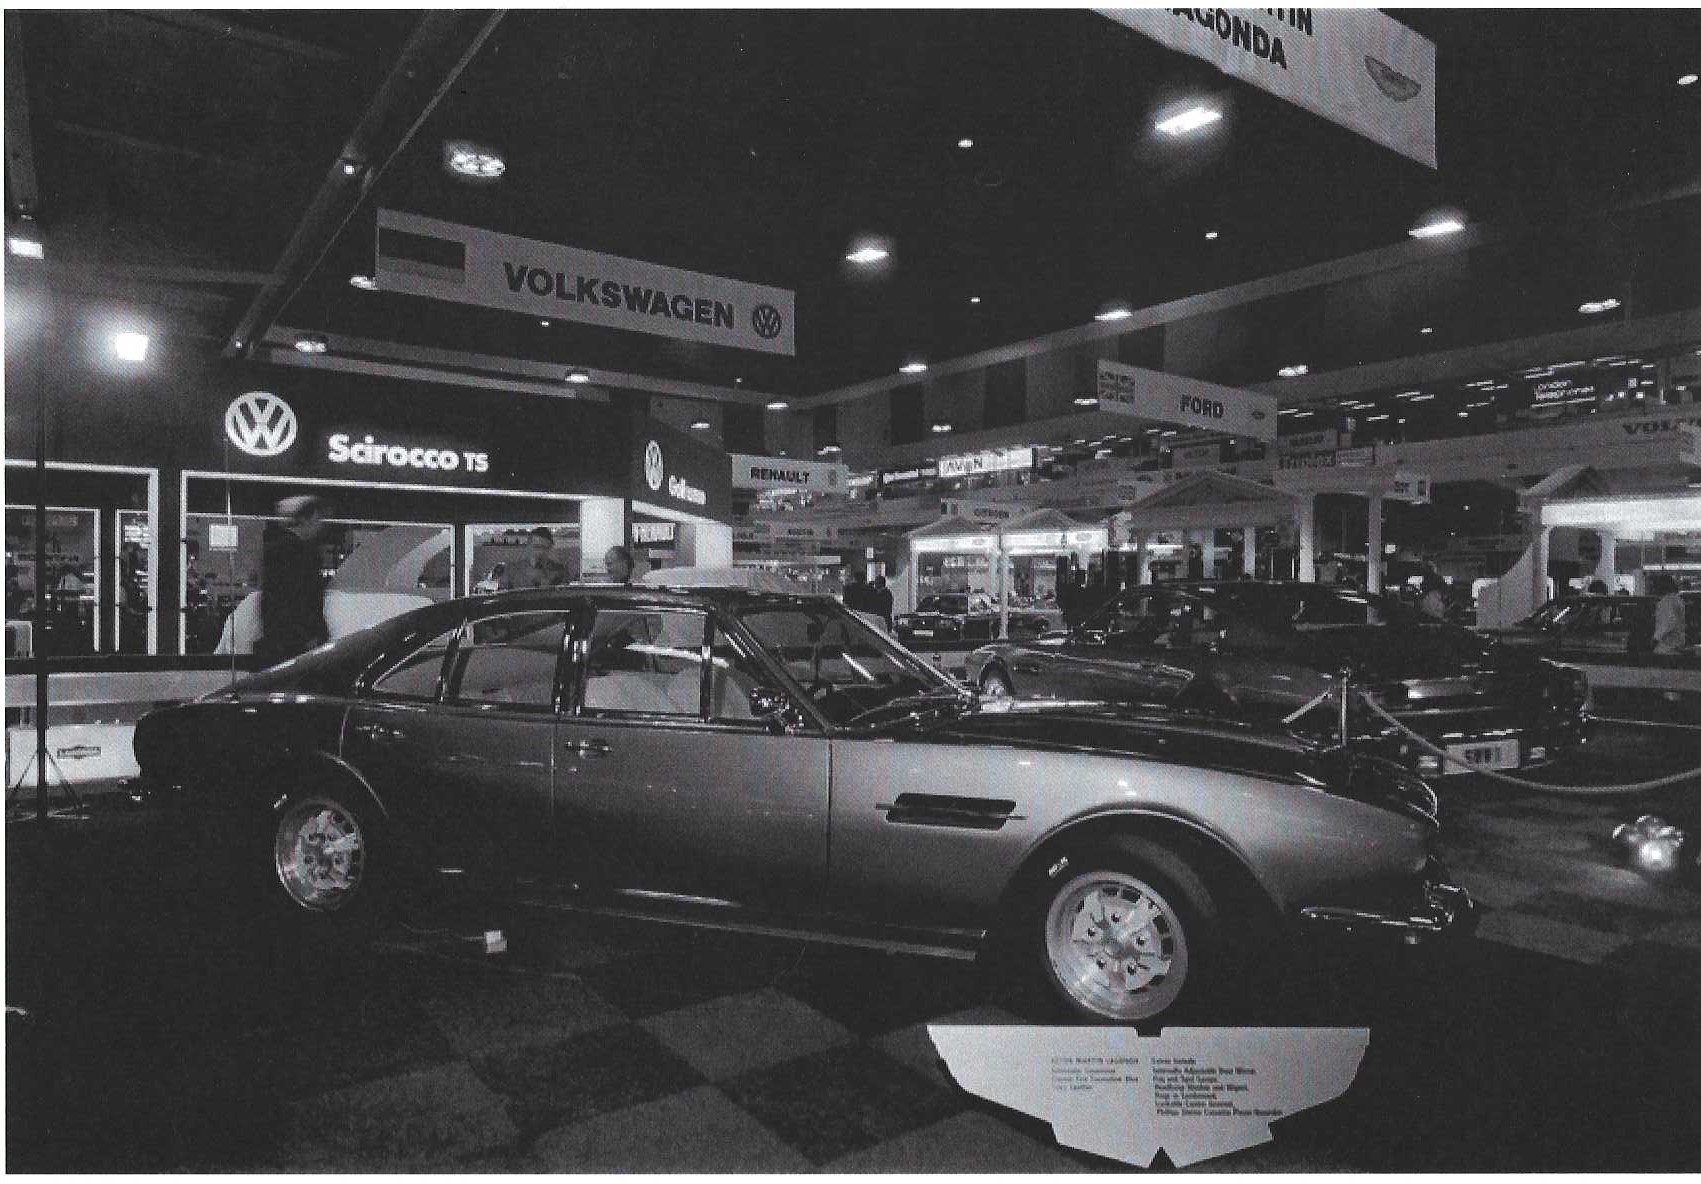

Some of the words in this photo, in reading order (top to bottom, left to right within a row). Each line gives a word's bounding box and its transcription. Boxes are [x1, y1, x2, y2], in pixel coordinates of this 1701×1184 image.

[504, 262, 734, 329] VOLKSWAGEN
[1180, 394, 1224, 419] FORD
[328, 433, 460, 471] Scirocco
[463, 452, 489, 472] TS
[751, 467, 810, 484] RENAULT
